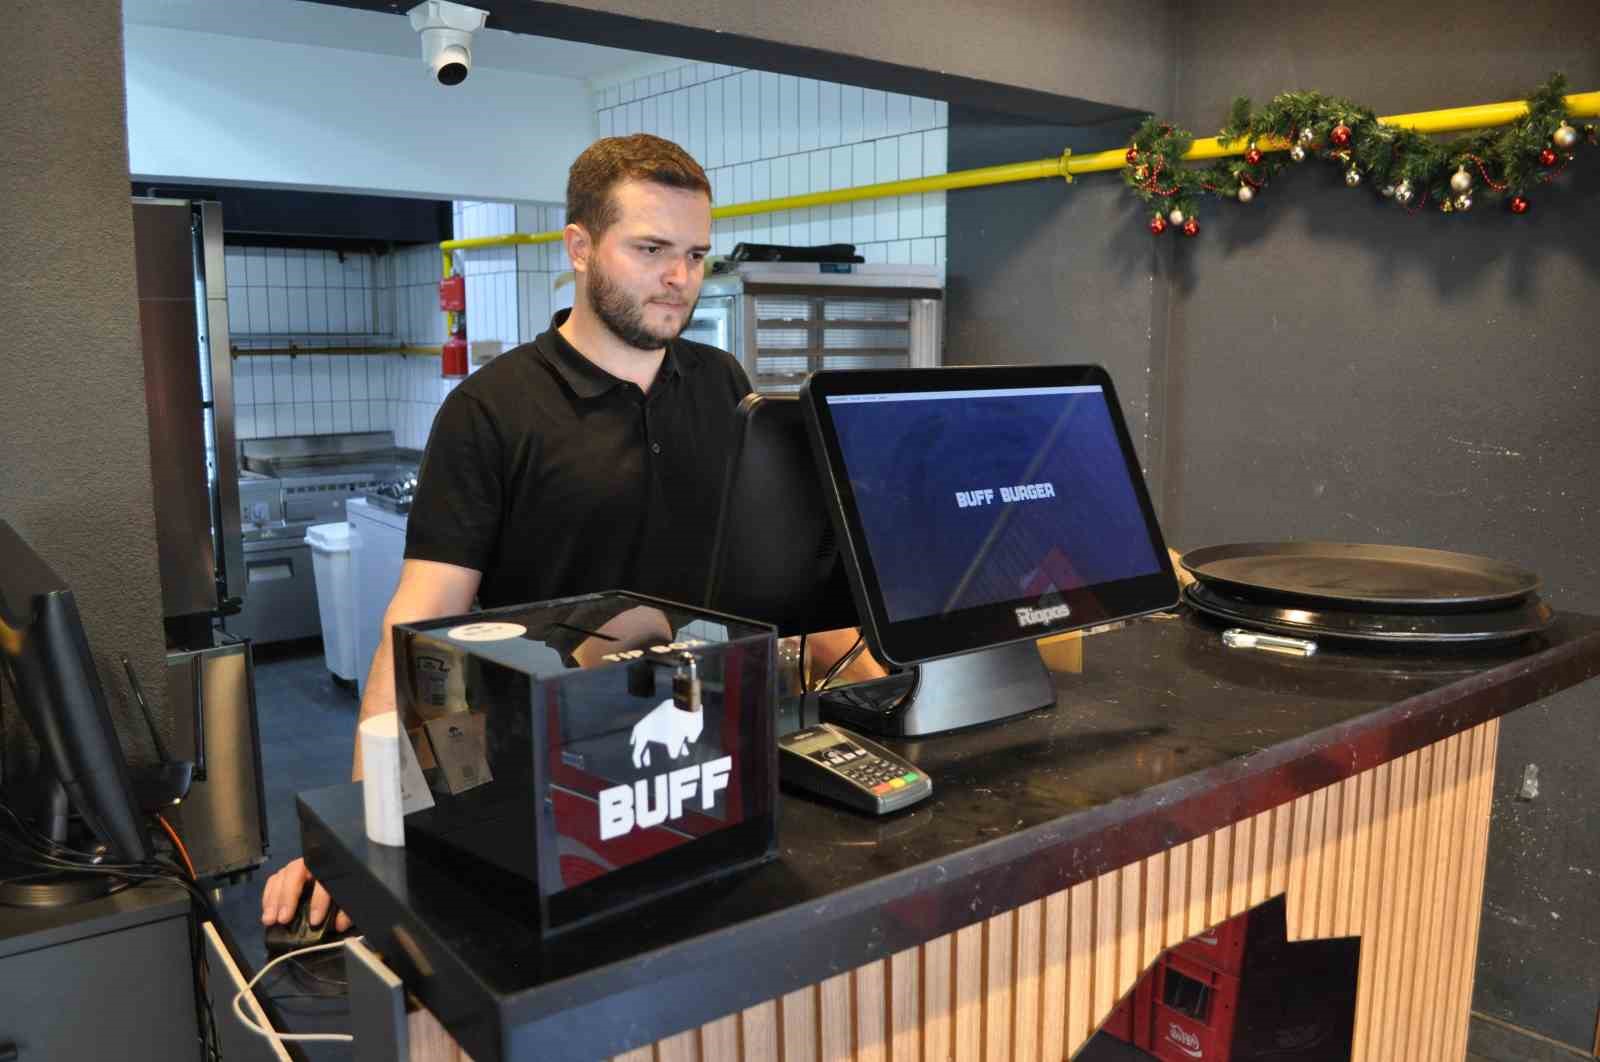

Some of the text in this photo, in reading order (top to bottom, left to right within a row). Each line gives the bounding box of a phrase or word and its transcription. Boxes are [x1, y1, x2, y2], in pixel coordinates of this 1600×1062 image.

[955, 482, 1056, 508] BUFF BURGER
[598, 755, 732, 841] BUFF
